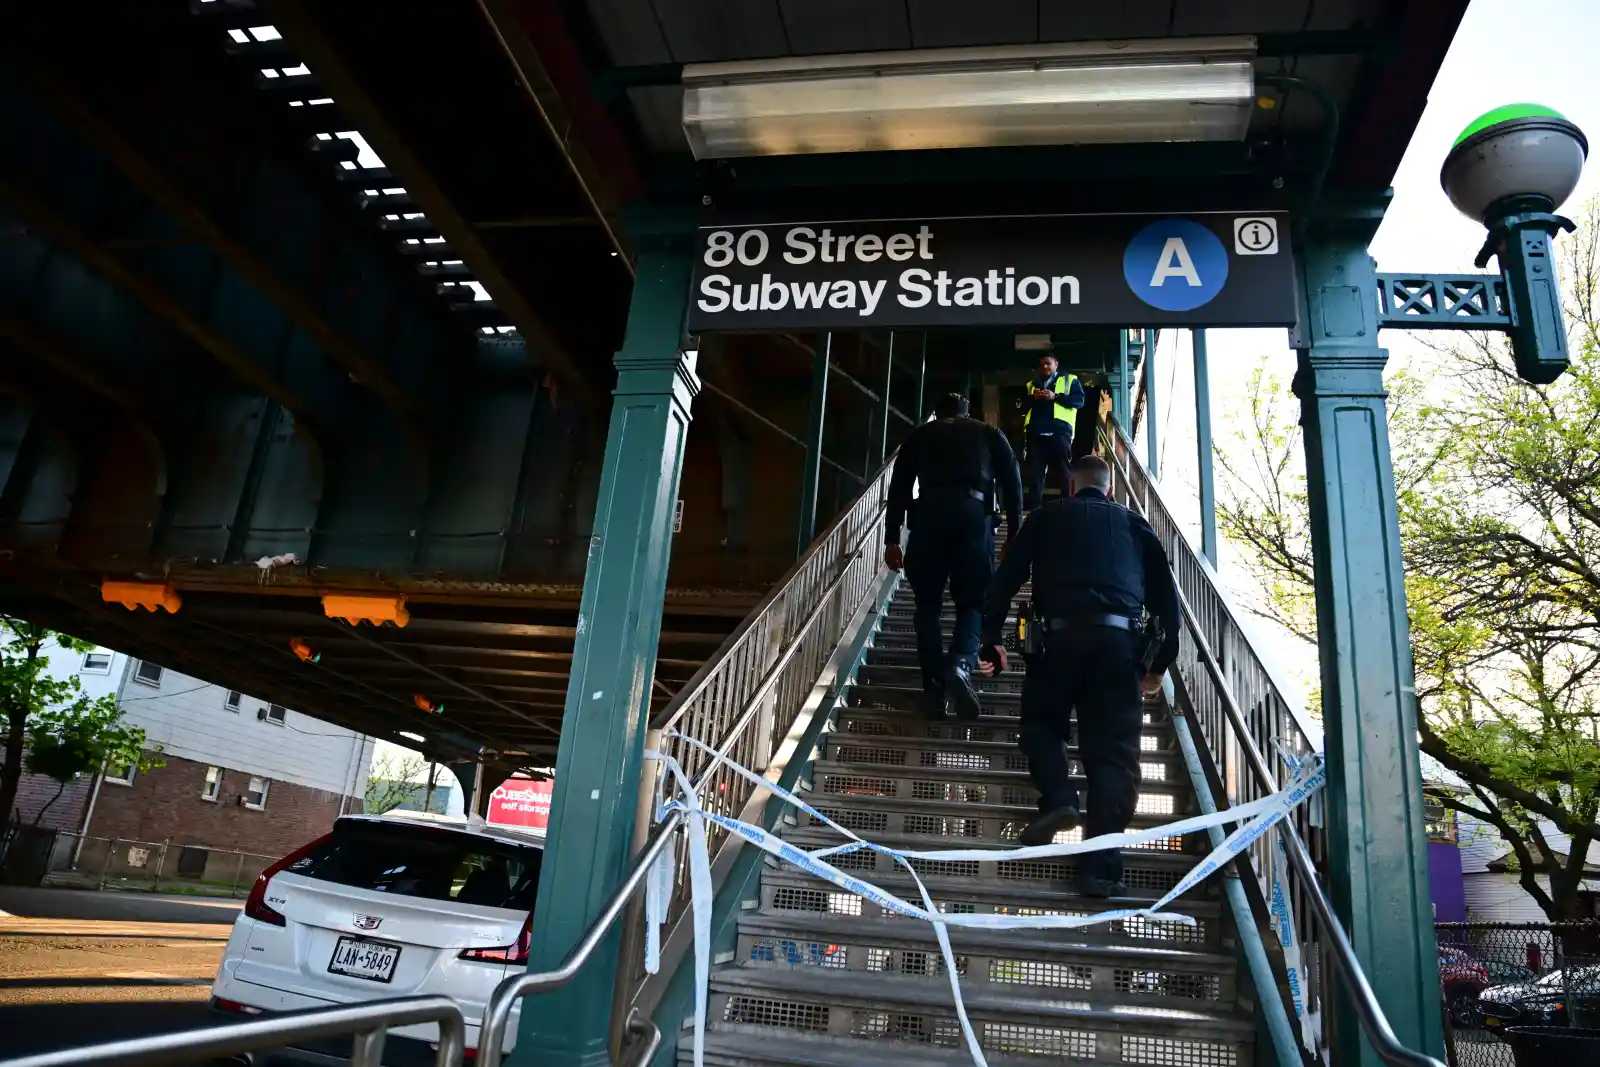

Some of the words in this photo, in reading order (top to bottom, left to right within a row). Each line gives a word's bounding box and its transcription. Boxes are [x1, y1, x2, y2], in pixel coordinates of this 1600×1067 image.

[703, 229, 770, 268] 80
[782, 225, 935, 265] Street
[1149, 236, 1203, 288] A
[697, 273, 888, 317] Subway
[896, 267, 1081, 309] Station
